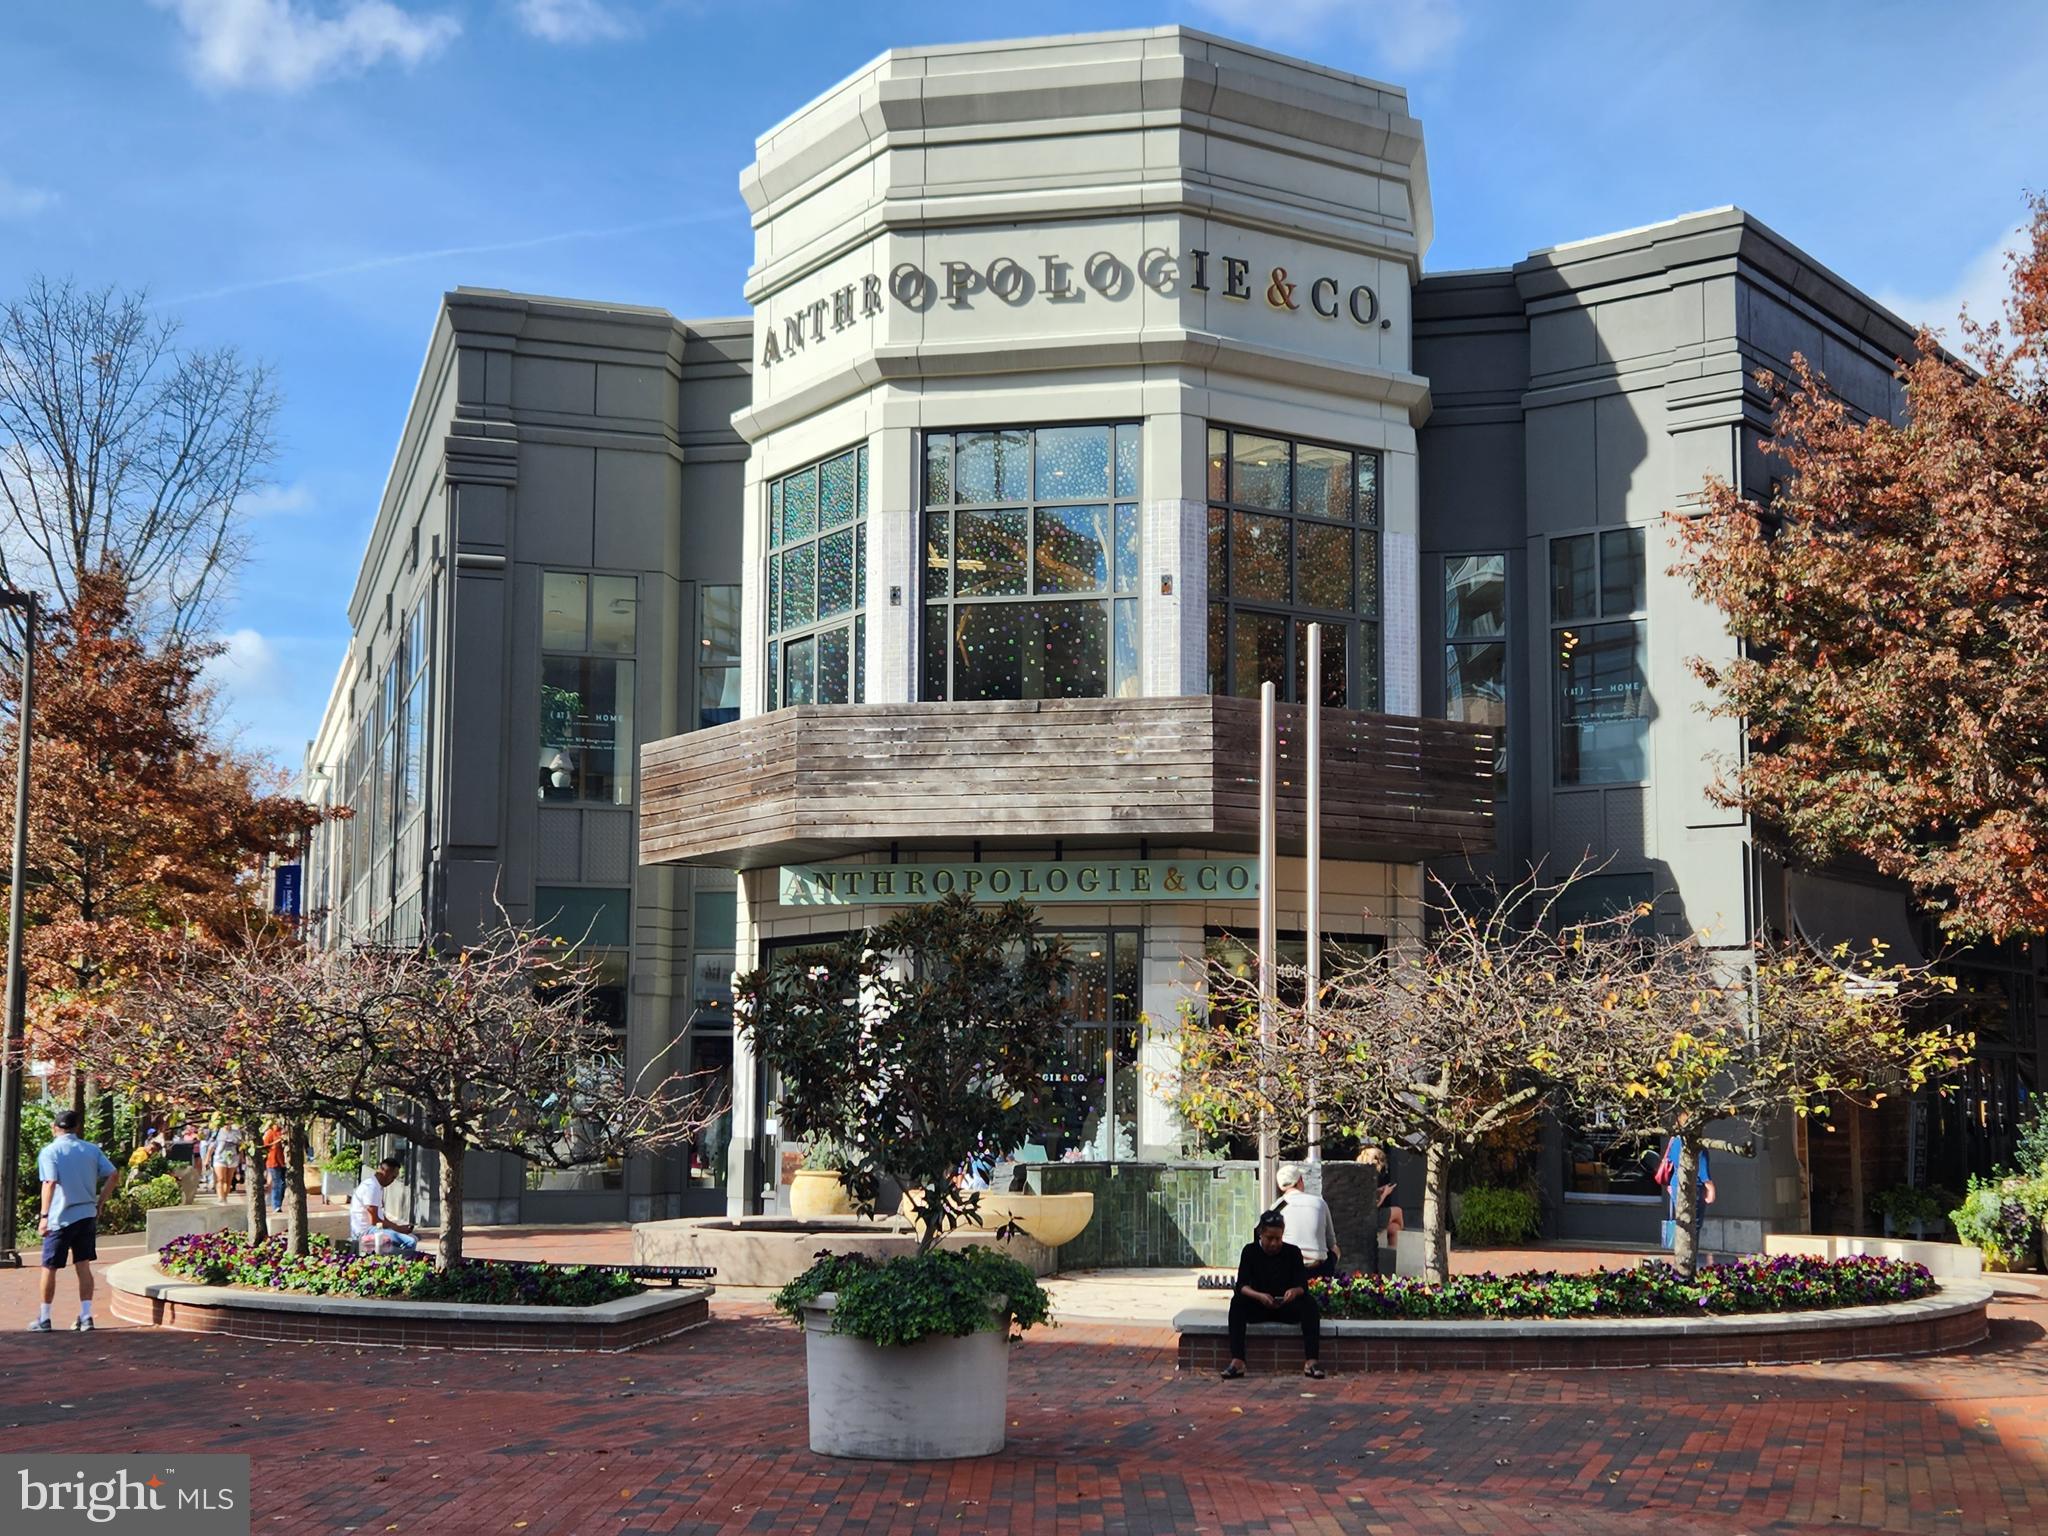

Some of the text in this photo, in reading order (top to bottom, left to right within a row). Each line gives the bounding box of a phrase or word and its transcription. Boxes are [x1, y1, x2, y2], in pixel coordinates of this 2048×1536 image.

[761, 247, 1391, 367] ANTHROPOLOGIE & CO.
[1610, 682, 1639, 692] HOME
[595, 714, 624, 722] HOME
[783, 866, 1259, 896] ANTHROPOLOGIE & CO.
